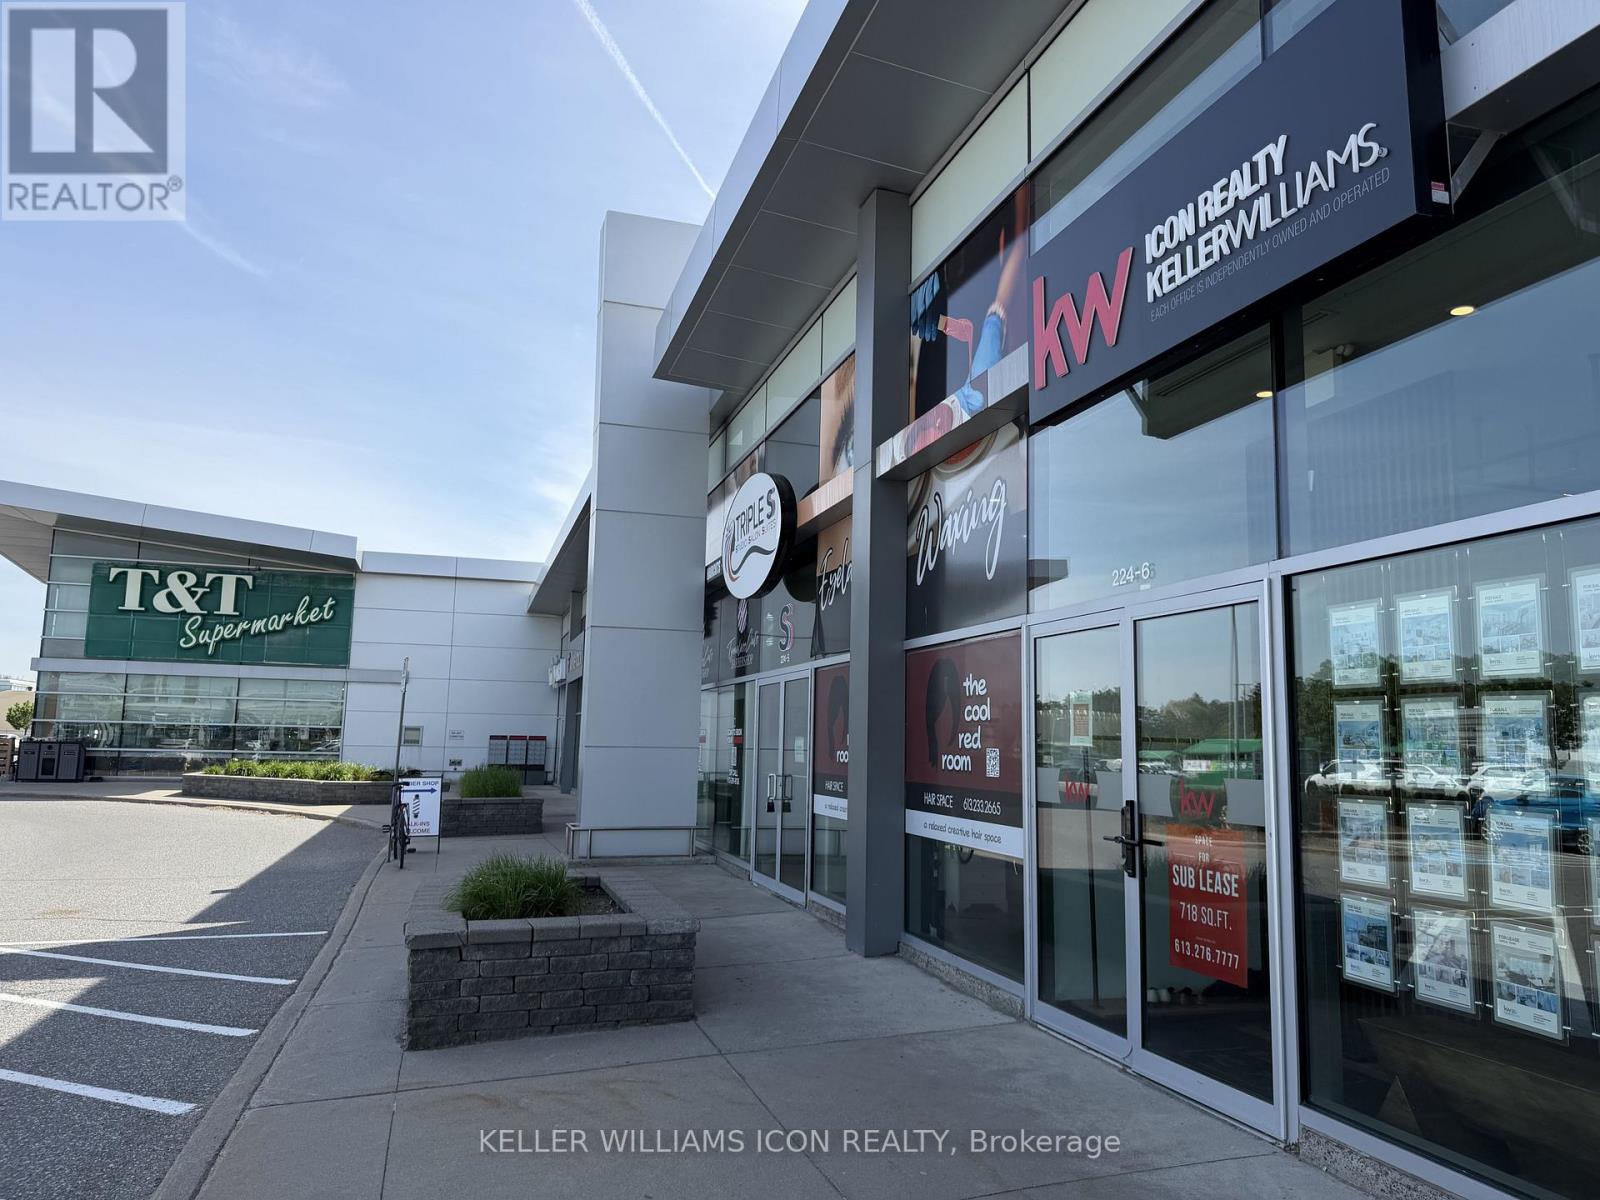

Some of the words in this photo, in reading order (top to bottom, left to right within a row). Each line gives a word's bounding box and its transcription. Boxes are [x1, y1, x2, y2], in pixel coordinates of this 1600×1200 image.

[1144, 202, 1195, 264] ICON
[1198, 134, 1288, 227] REALTY
[1150, 303, 1170, 322] EACH
[1170, 285, 1196, 310] OFFICE
[1196, 280, 1205, 294] IS
[1205, 239, 1273, 288] INDEPENDENTLY
[1272, 217, 1307, 248] OWNED
[1309, 203, 1331, 228] AND
[1333, 167, 1390, 213] OPERATED
[1033, 246, 1133, 390] kw
[736, 495, 764, 541] TRIPLE
[766, 487, 776, 520] S
[916, 479, 1006, 585] Waxing
[1112, 562, 1150, 586] 224-6
[109, 567, 253, 616] T&T
[179, 594, 336, 656] Supermarket
[963, 673, 987, 697] the
[964, 697, 991, 722] cool
[958, 725, 982, 749] red
[941, 753, 972, 772] room
[923, 791, 936, 806] HAIR
[936, 794, 954, 809] SPACE
[963, 797, 1001, 815] 613.233.2665
[923, 822, 928, 830] a
[928, 820, 947, 833] relaxed
[947, 824, 970, 840] creative
[971, 829, 983, 841] hair
[983, 833, 1002, 845] space
[1198, 852, 1210, 864] FOR
[1172, 864, 1195, 889] SUB
[1199, 868, 1240, 898] LEASE
[1179, 901, 1198, 923] 718
[1201, 906, 1233, 930] SQ.FT.
[1174, 938, 1240, 970] 613.276.7777
